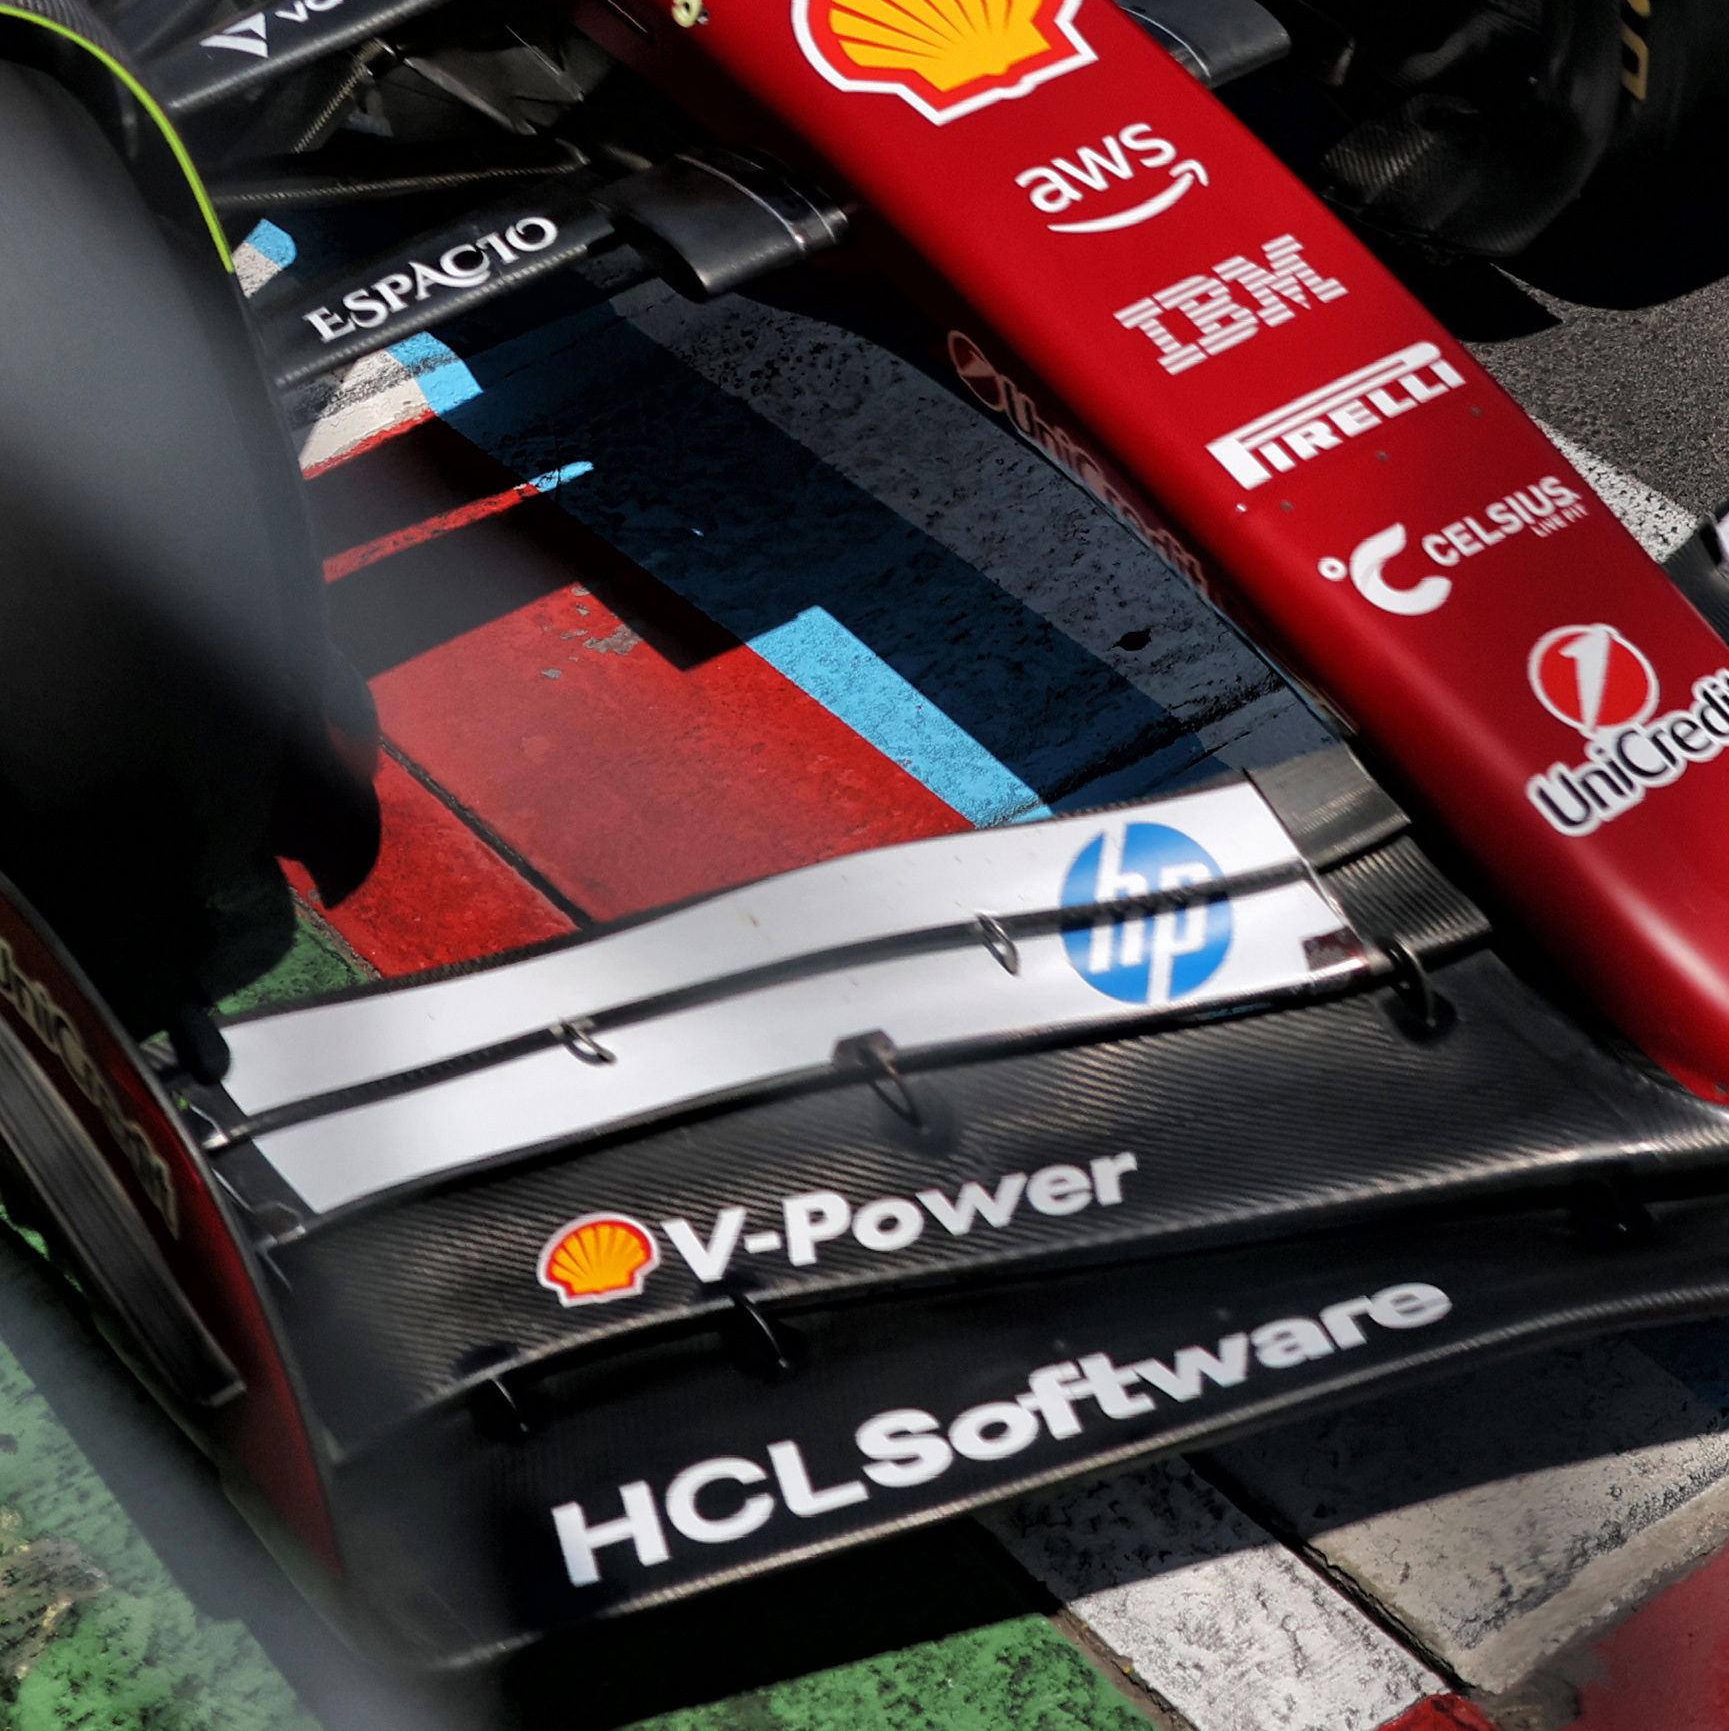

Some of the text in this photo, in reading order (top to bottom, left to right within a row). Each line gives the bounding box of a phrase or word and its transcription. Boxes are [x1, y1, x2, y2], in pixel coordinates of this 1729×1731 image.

[1014, 122, 1177, 214] aws
[303, 214, 560, 343] ESPACIO
[1113, 233, 1350, 376] IBM
[1204, 340, 1467, 490] PIRELLI
[1422, 475, 1582, 567] CELSIUS
[1531, 503, 1589, 539] LIVE FIT
[666, 1148, 1138, 1284] V-Power
[550, 1280, 1453, 1587] HCLSoftware
